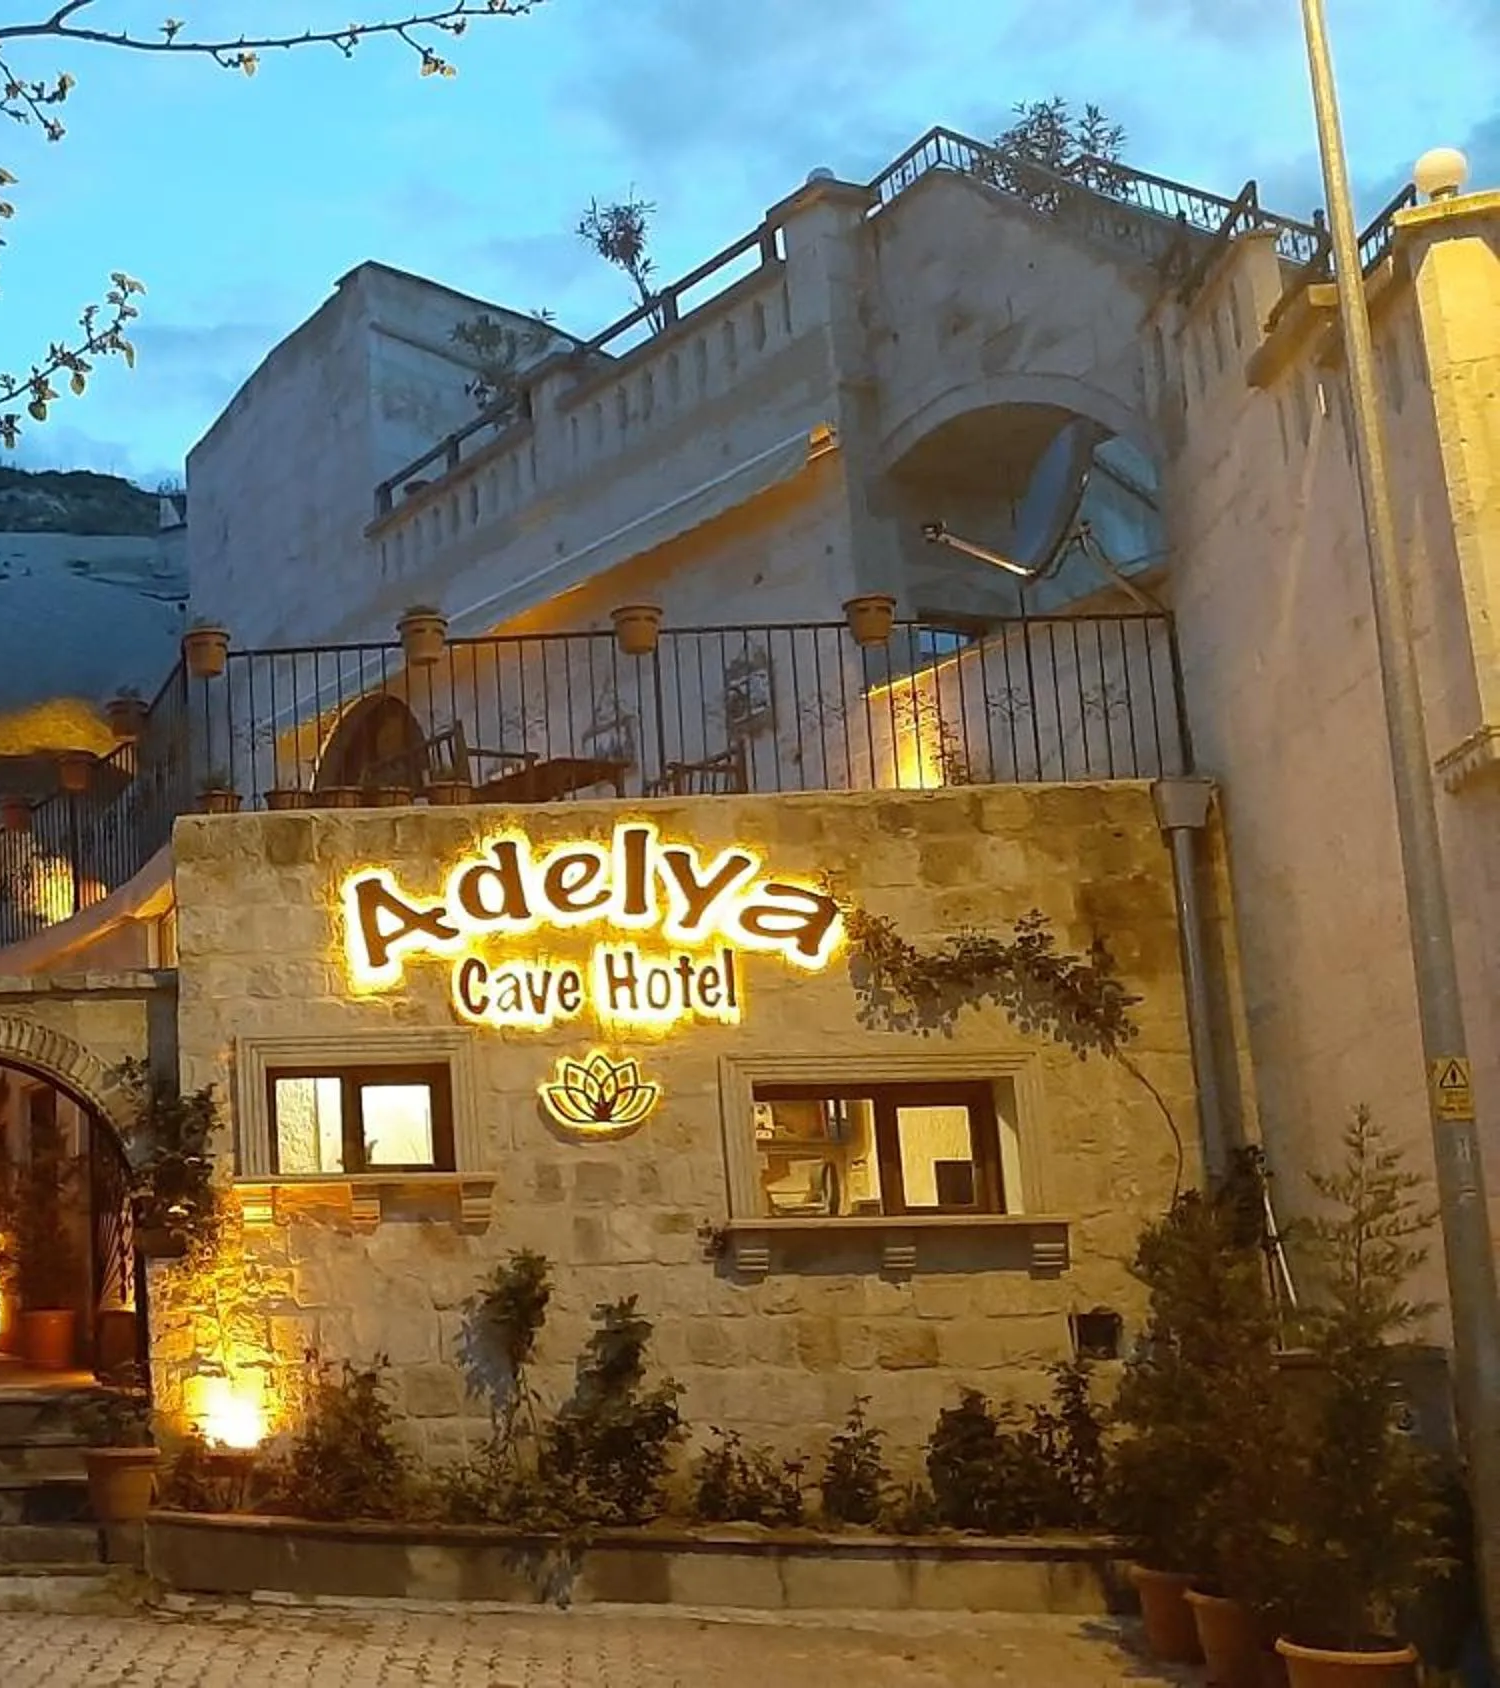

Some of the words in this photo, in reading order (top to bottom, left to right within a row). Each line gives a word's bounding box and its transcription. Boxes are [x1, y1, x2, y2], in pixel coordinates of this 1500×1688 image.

[354, 829, 838, 968] Adelya
[458, 957, 582, 1014] Cave
[604, 948, 738, 1012] Hotel
